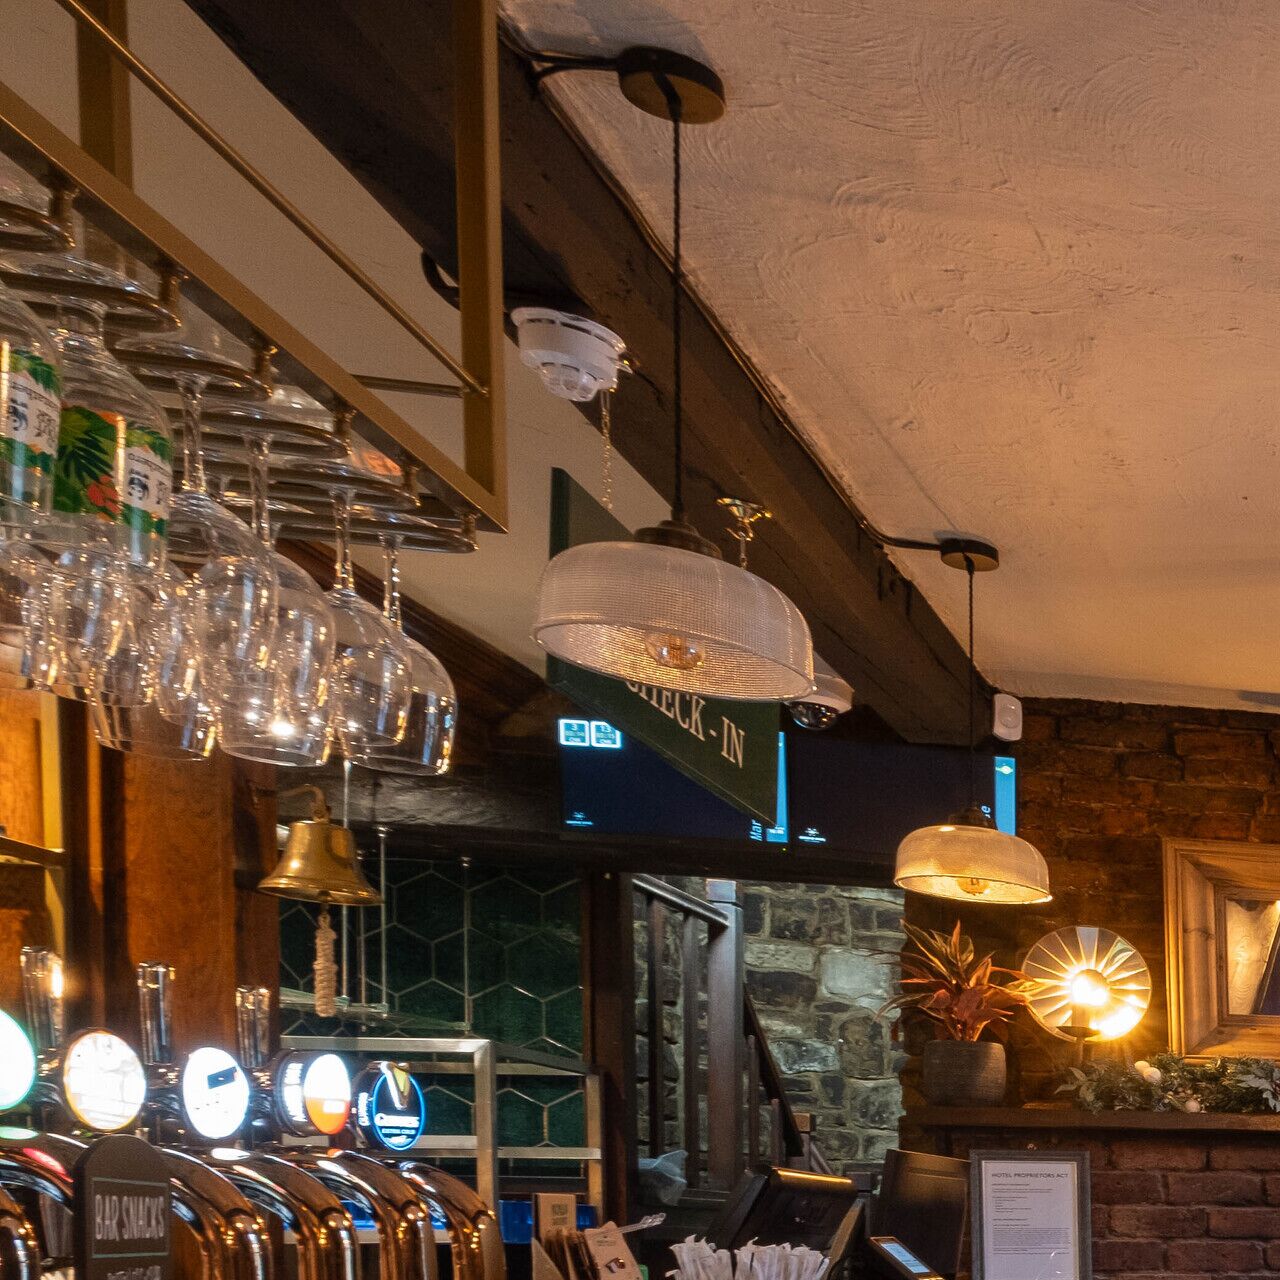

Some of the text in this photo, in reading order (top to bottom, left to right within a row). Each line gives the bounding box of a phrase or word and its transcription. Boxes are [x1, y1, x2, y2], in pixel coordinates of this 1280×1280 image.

[625, 681, 706, 741] ECK
[721, 716, 745, 768] IN
[95, 1194, 164, 1241] BAR SNACKS
